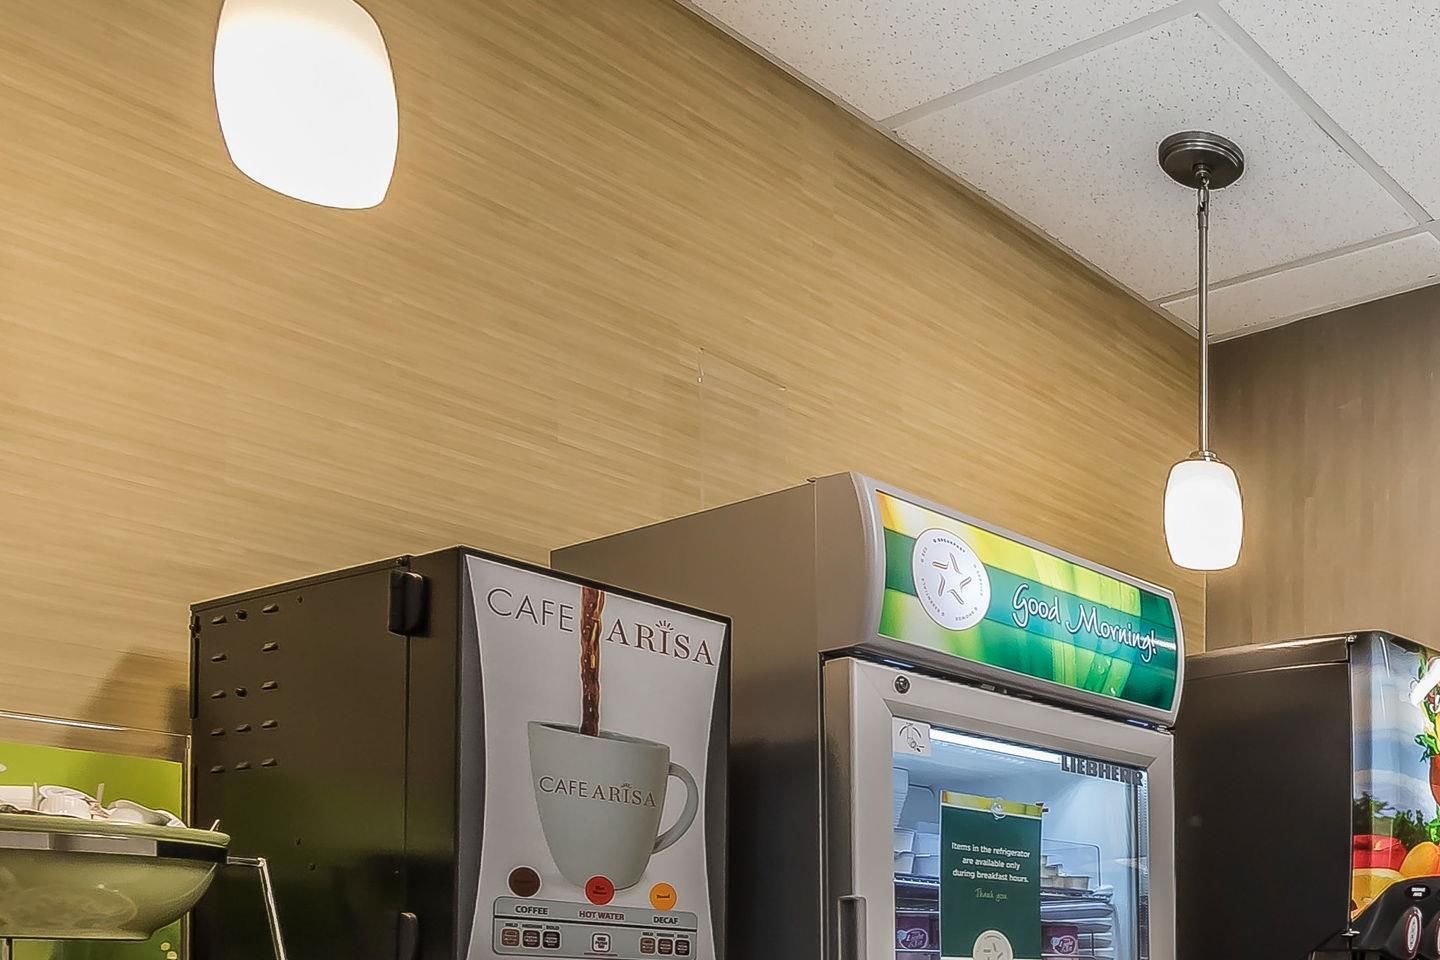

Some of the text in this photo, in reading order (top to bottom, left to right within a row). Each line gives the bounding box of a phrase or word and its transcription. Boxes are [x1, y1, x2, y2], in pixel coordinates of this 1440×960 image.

[487, 587, 715, 667] CAFE ARISA
[1011, 583, 1158, 663] Good Morning!
[1060, 754, 1144, 787] LIEBHERR
[539, 776, 657, 807] CAFE ARISA
[951, 842, 1031, 858] Items in the refrigerator
[974, 858, 1005, 868] available
[1006, 861, 1021, 871] only
[952, 869, 975, 880] during
[976, 870, 1008, 881] breakfast
[515, 905, 548, 915] COFFEE
[579, 910, 625, 921] HOT WATER
[653, 916, 679, 925] DECAF
